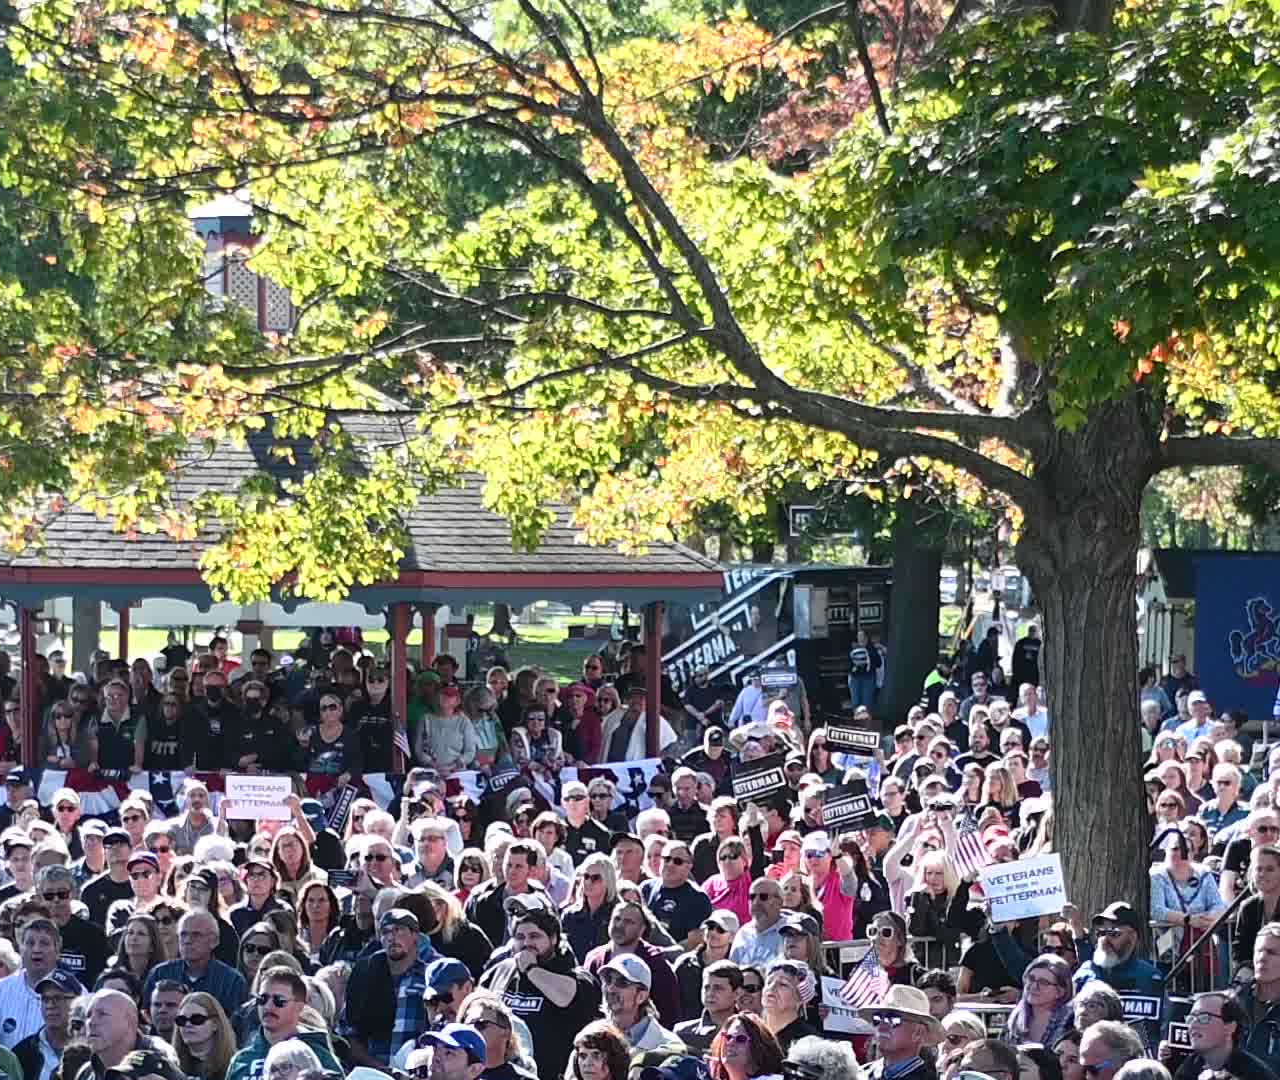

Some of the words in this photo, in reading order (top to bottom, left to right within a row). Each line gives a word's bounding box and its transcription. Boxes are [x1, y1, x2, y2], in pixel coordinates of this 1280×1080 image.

[831, 731, 875, 745] FETTERMAN
[232, 785, 287, 794] VETERANS
[823, 799, 867, 818] FETTERMAN
[988, 866, 1054, 886] VETERANS
[989, 887, 1062, 905] FETTERMAN
